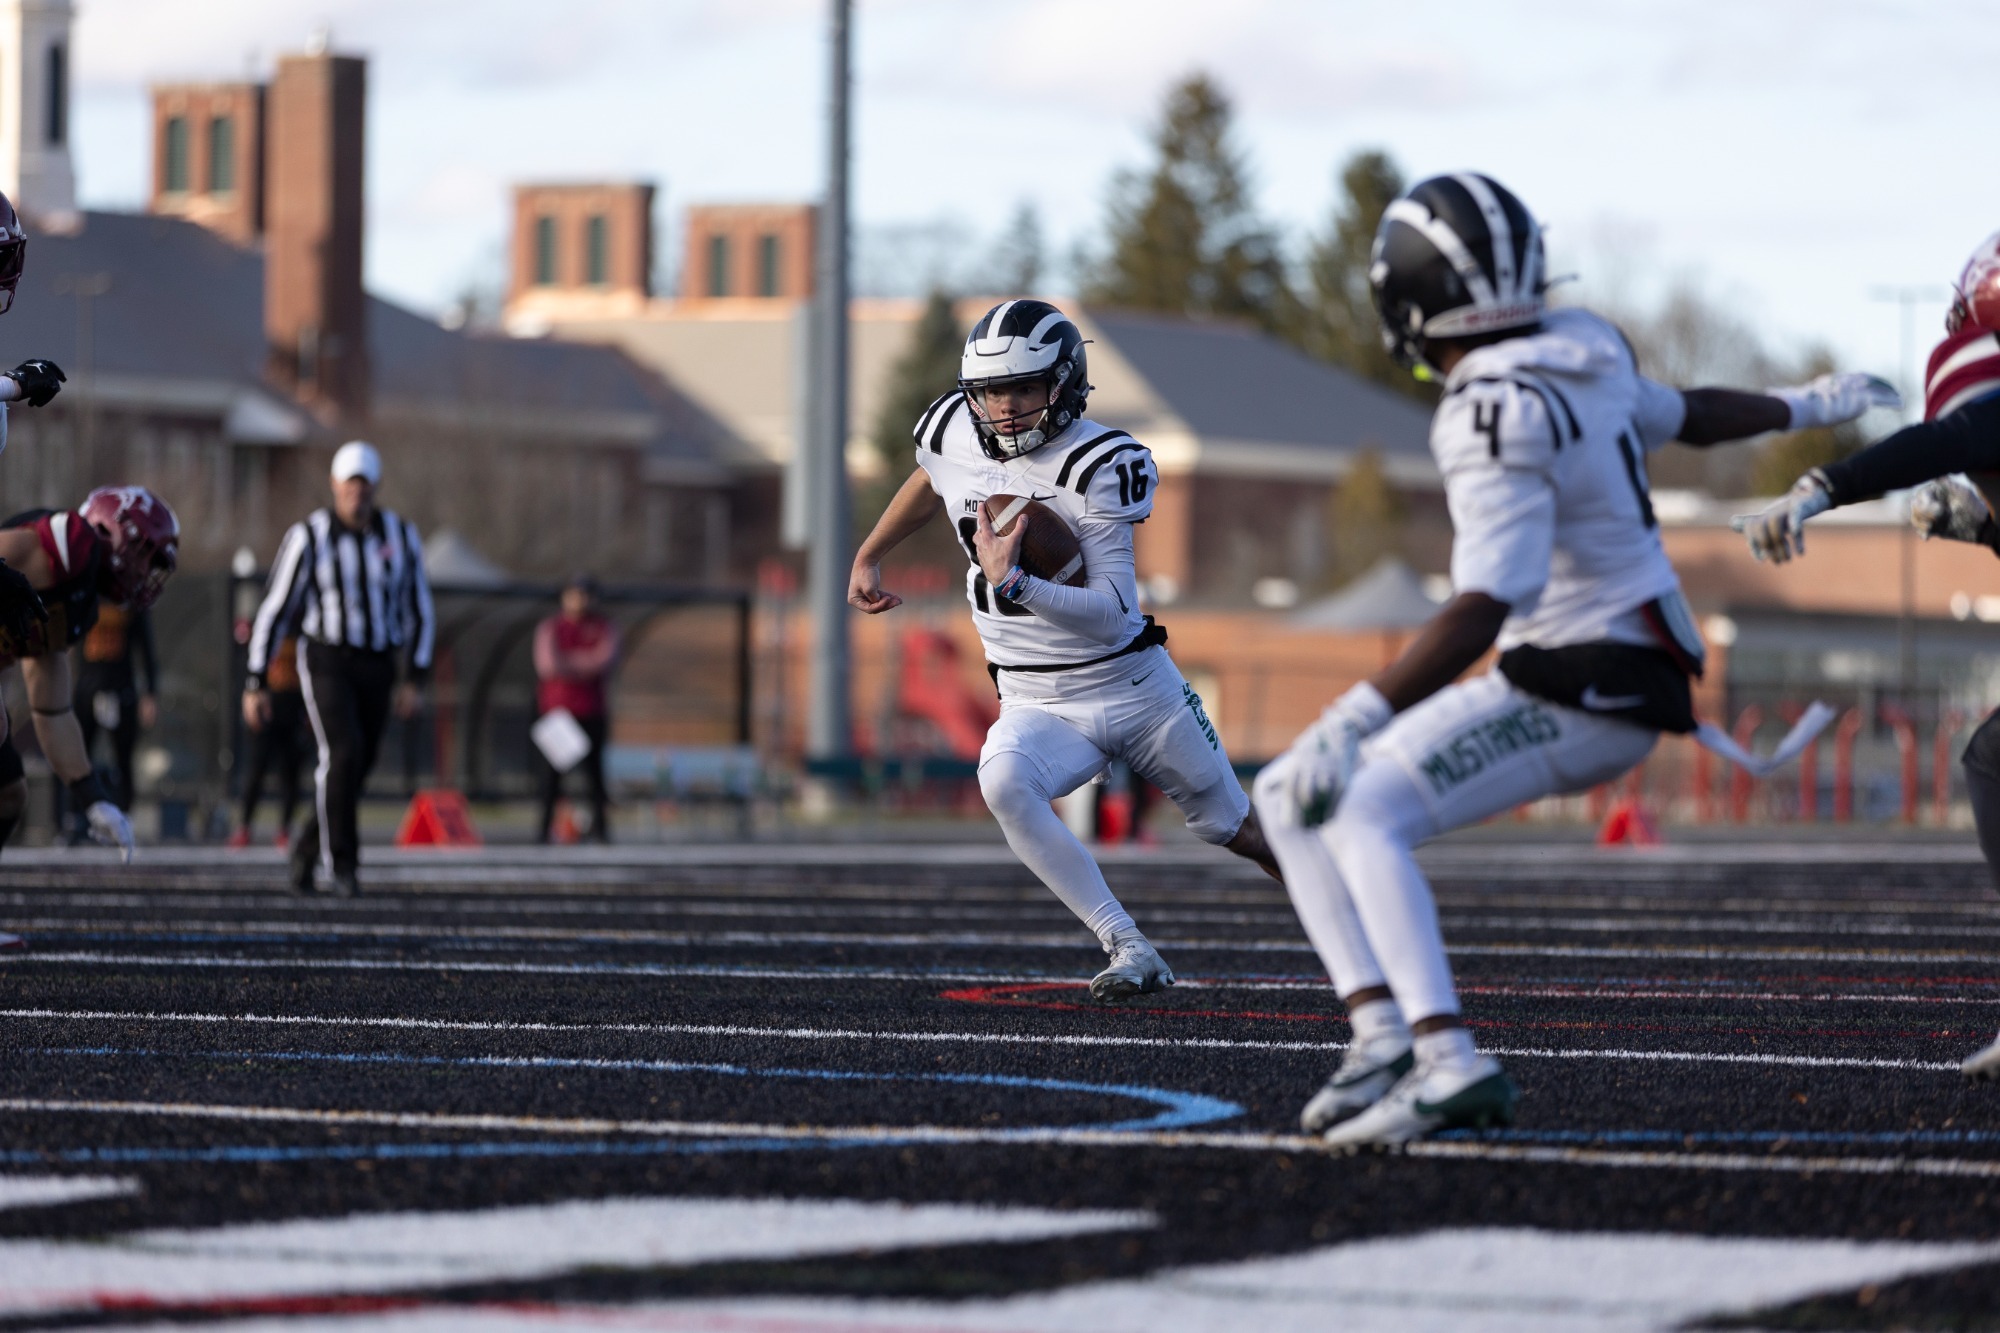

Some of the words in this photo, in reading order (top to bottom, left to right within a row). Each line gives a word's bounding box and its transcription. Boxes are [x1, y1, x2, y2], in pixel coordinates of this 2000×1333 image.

[1475, 400, 1501, 459] 4
[1115, 458, 1149, 507] 16
[1420, 703, 1561, 797] MUSTANGS
